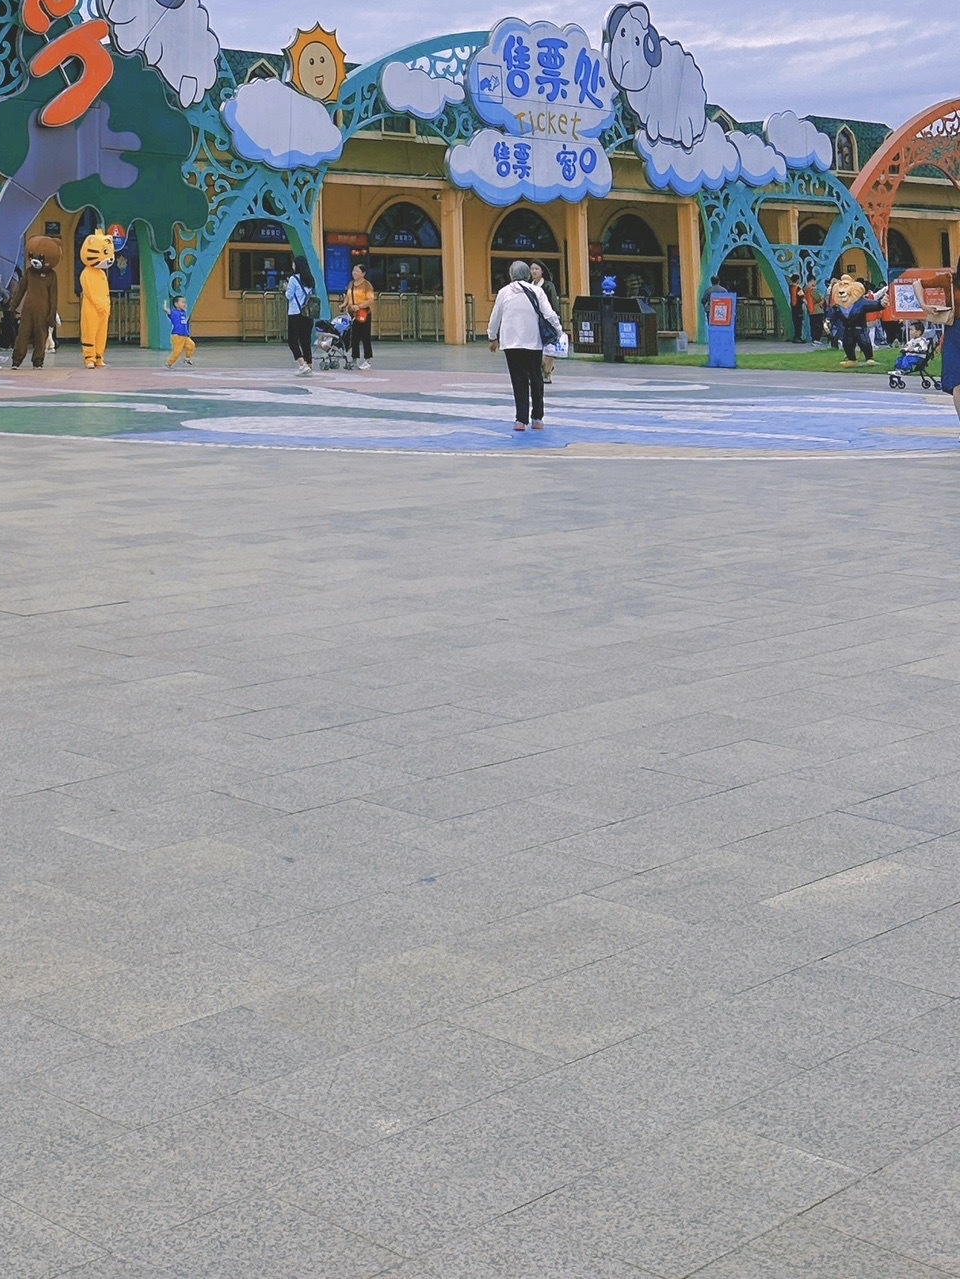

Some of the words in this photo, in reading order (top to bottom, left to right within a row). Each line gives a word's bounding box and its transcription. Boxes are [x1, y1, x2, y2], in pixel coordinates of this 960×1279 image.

[503, 34, 606, 109] 售票处
[493, 141, 532, 180] 售票
[556, 144, 597, 182] 窗口
